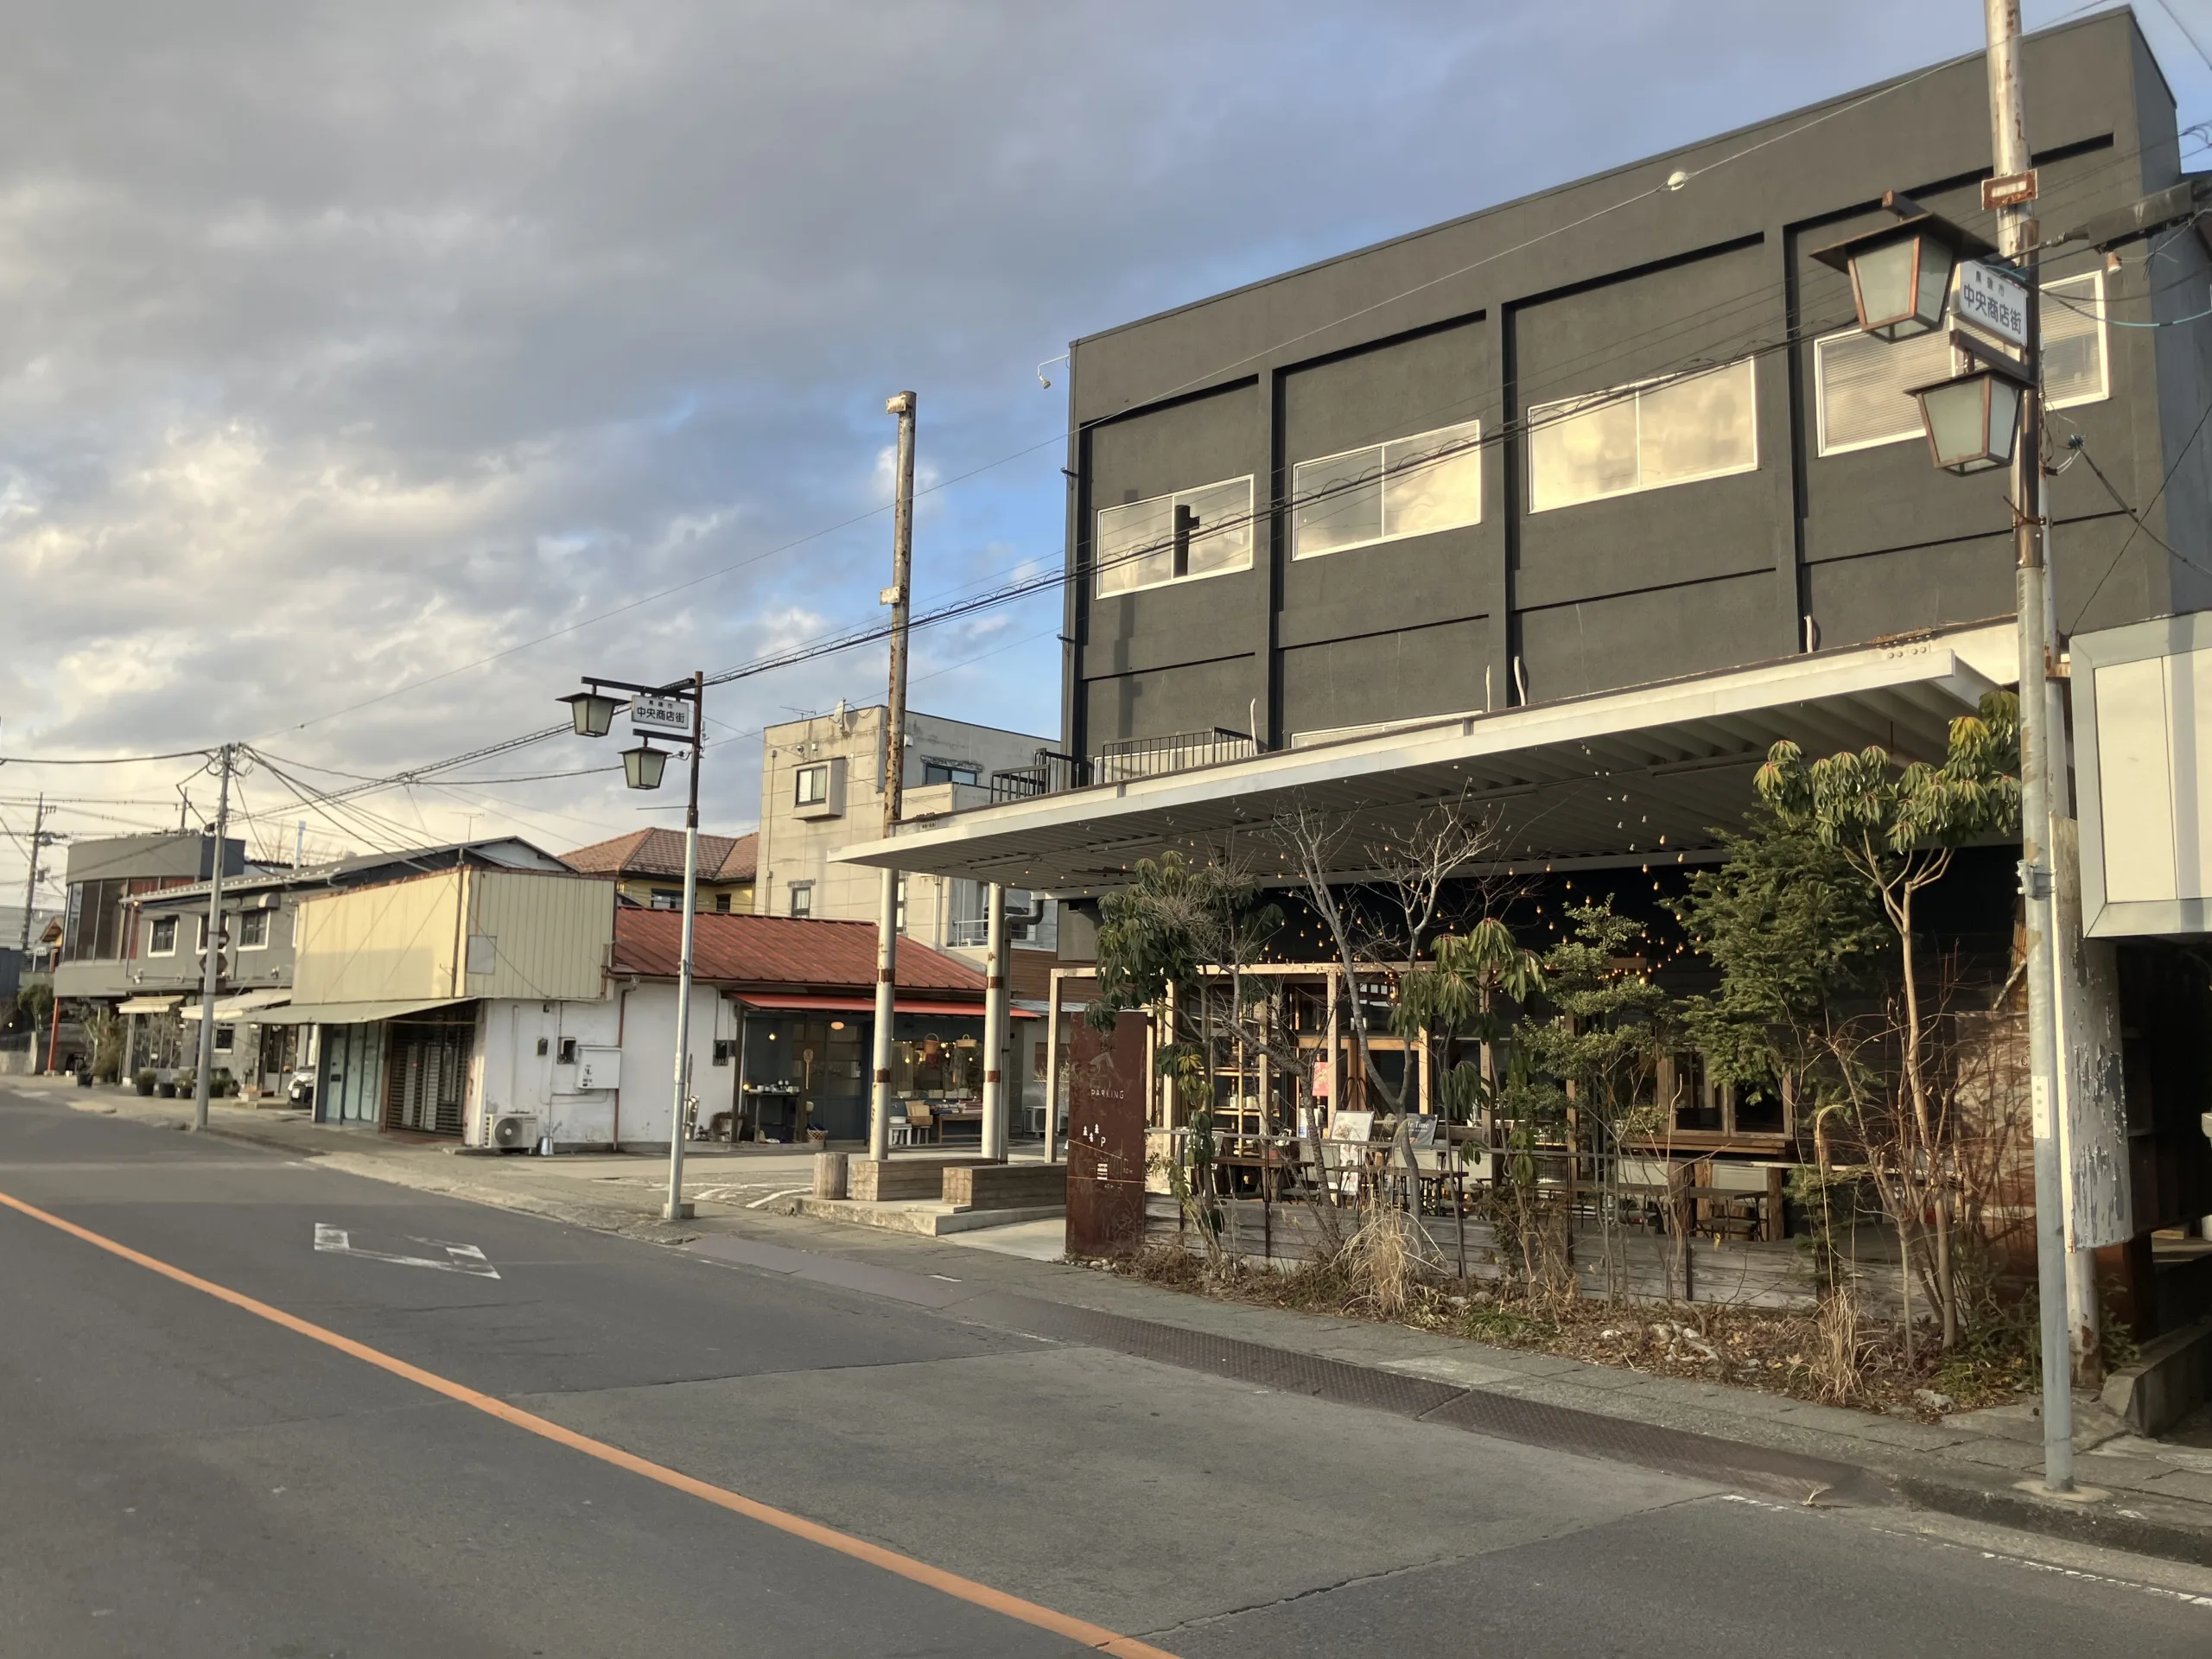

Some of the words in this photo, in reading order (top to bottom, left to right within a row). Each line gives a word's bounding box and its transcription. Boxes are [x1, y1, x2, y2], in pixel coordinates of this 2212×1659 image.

[1963, 283, 2022, 335] 中央商店街
[637, 706, 685, 724] 中央商店街
[1090, 1089, 1124, 1100] PARKING
[1100, 1136, 1107, 1147] P
